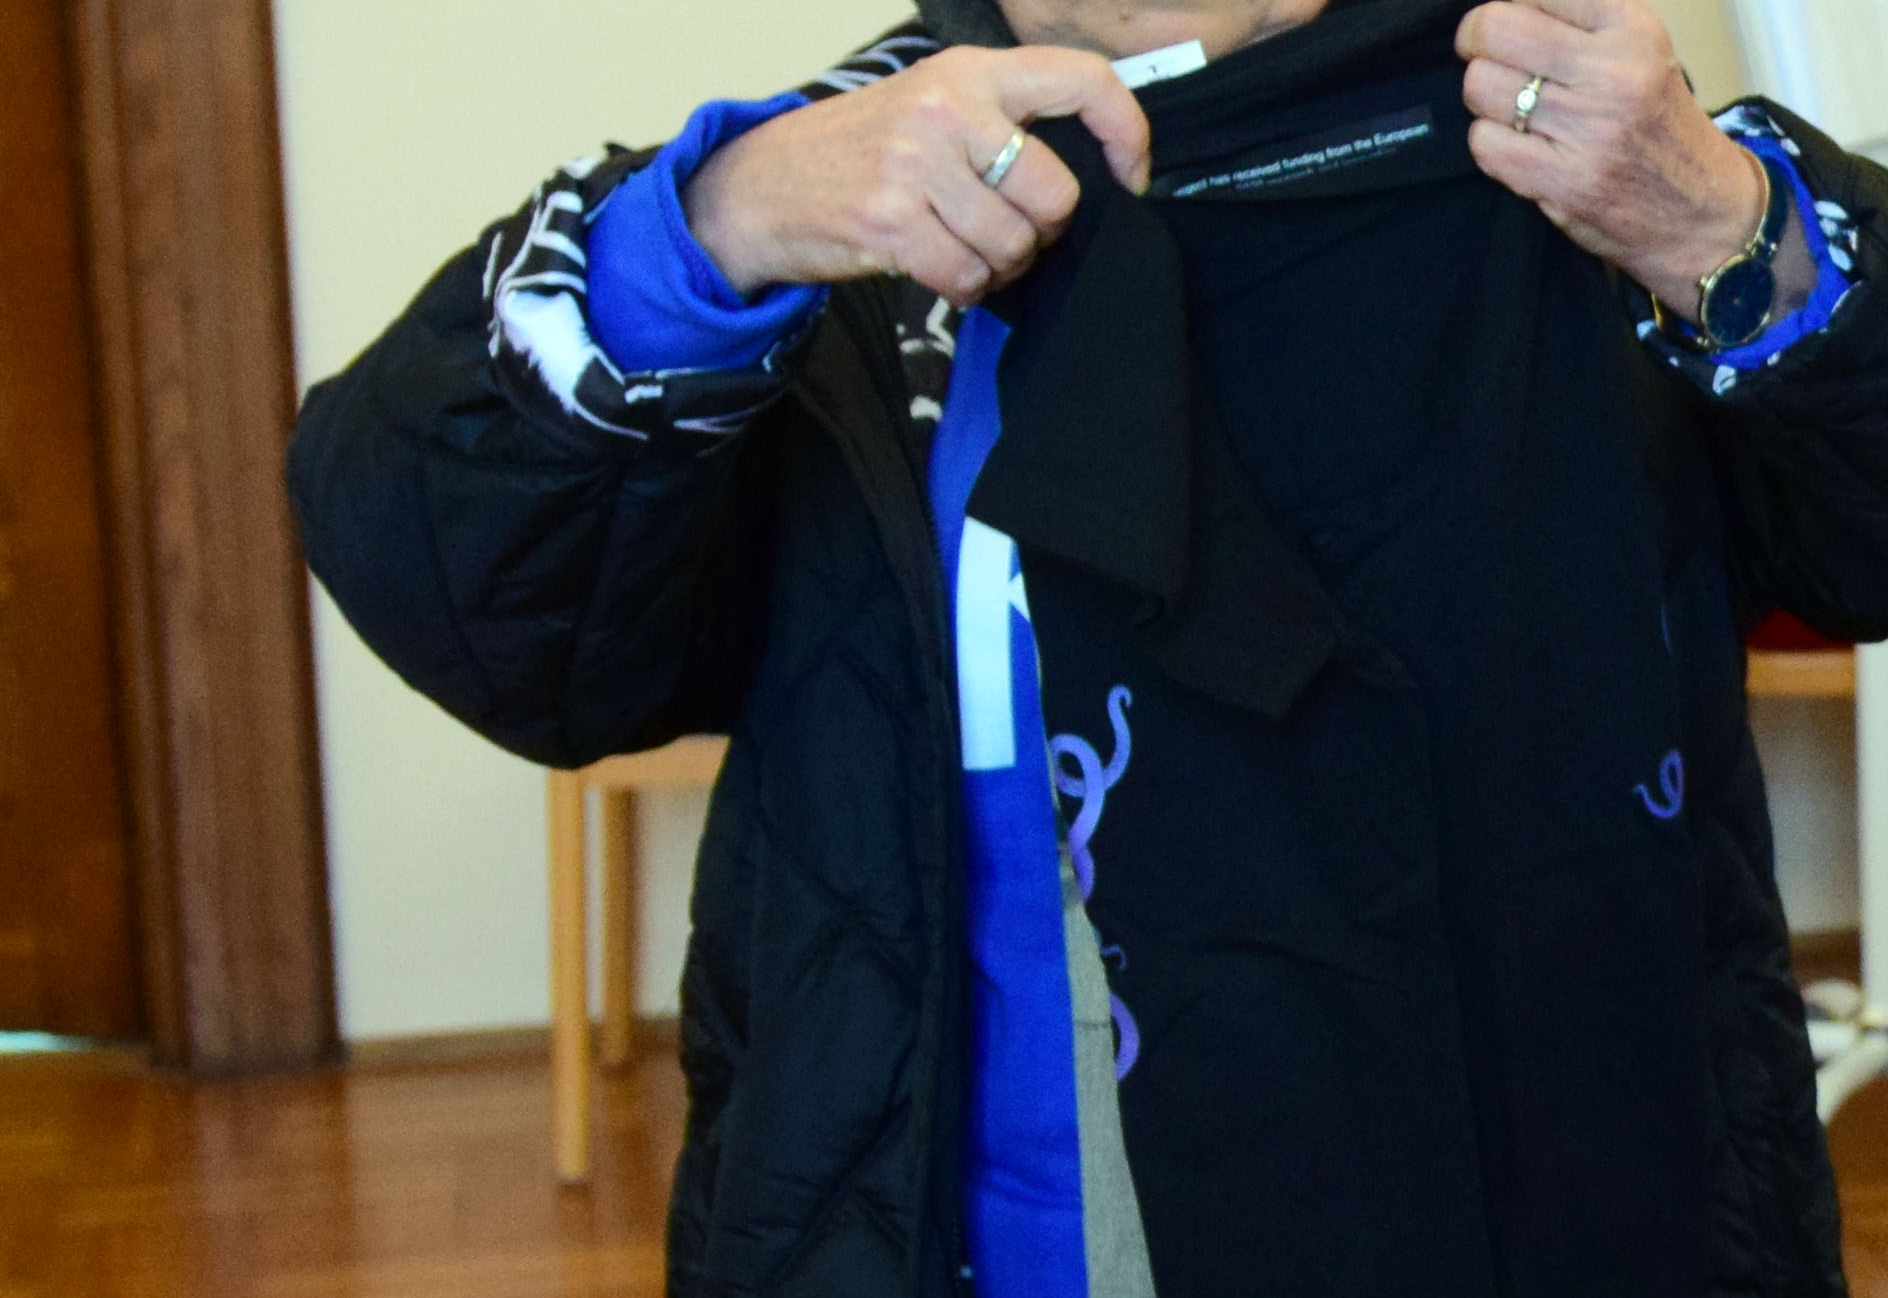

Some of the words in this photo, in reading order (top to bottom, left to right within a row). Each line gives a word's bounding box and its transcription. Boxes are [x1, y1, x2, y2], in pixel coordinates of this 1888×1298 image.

[1232, 162, 1281, 181] received
[1282, 150, 1325, 170] funding
[1325, 143, 1353, 158] from
[1353, 139, 1373, 150] the
